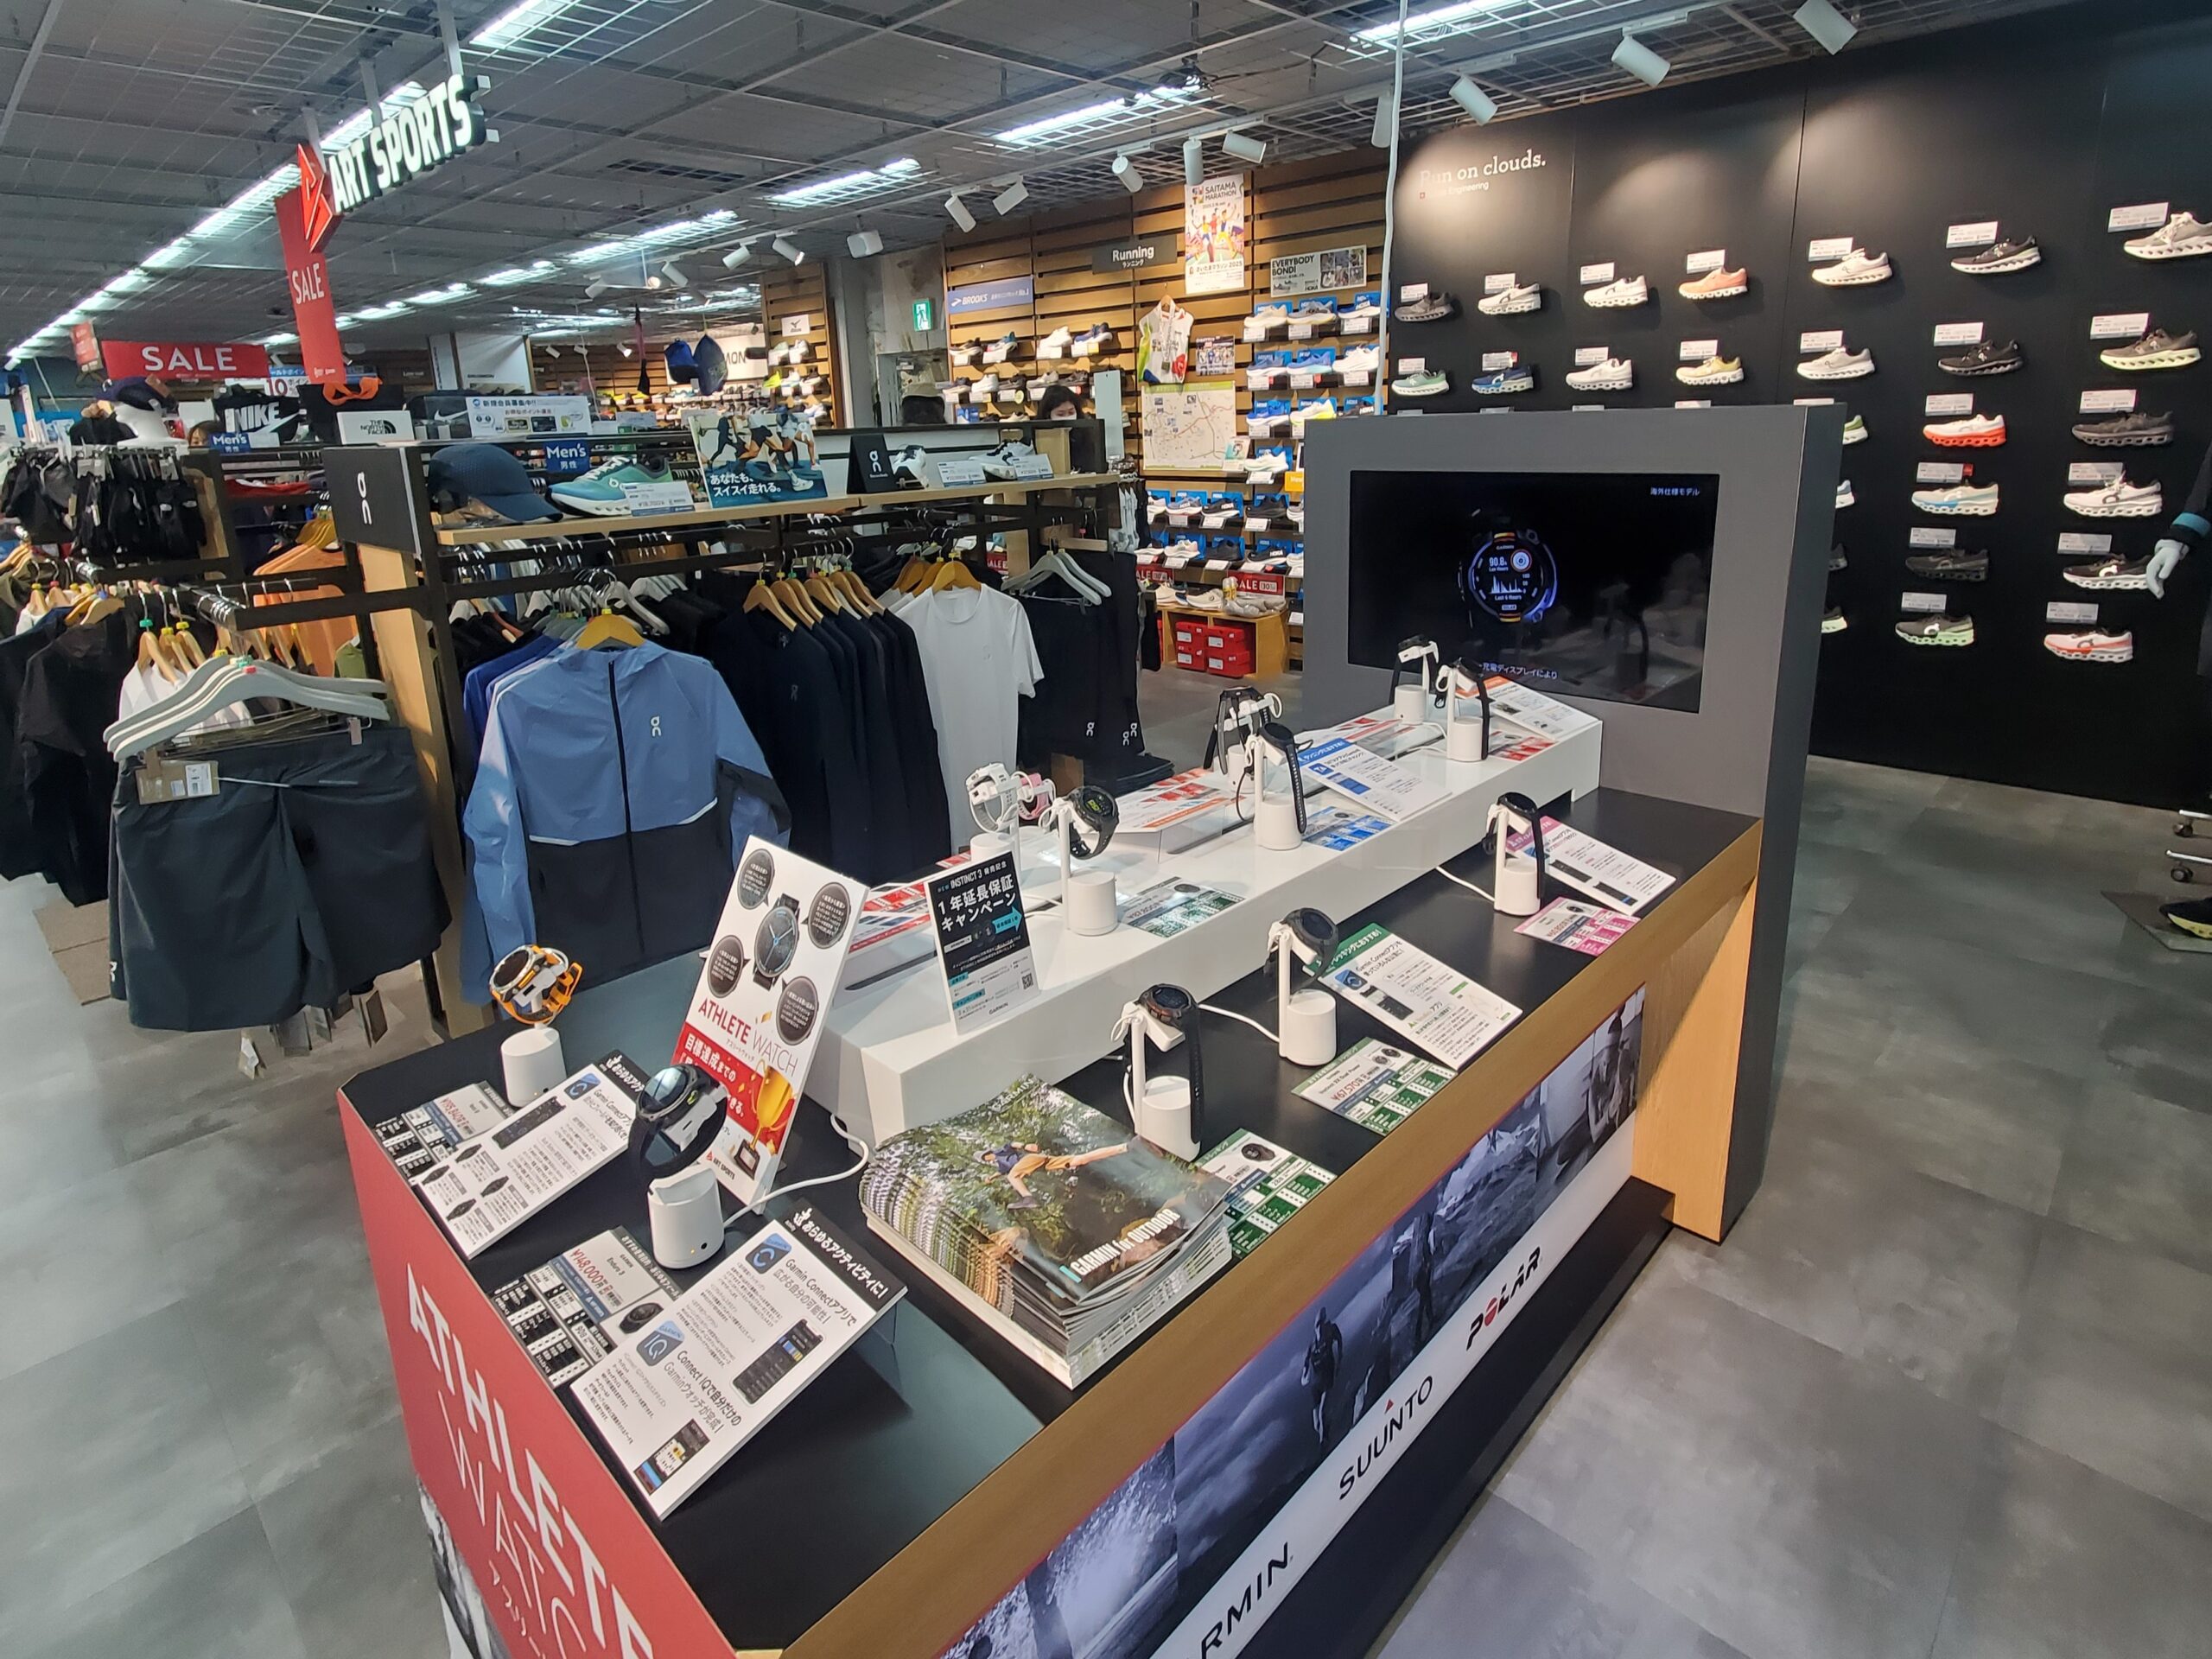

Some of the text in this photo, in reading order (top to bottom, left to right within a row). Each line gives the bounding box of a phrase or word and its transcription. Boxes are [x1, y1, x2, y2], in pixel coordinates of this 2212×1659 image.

[328, 74, 472, 213] ART SPORTS
[1457, 166, 1478, 180] on
[1484, 149, 1546, 175] clouds.
[1205, 181, 1236, 194] SAITAMA
[1205, 190, 1236, 200] MARATHON
[1112, 245, 1155, 264] Running
[1272, 256, 1315, 270] EVERYBODY
[1272, 265, 1297, 275] BONDI
[291, 262, 325, 306] SALE
[962, 295, 988, 306] BROOKS
[142, 346, 238, 372] SALE
[233, 402, 281, 433] NIKE
[546, 443, 587, 460] Men's
[560, 461, 577, 471] 男性
[710, 474, 754, 485] あなたも、
[714, 485, 782, 498] スイスイ走れる。
[1649, 487, 1700, 497] 海外仕様モデル
[949, 870, 977, 889] INSTINCT
[976, 868, 982, 878] 3
[939, 891, 1017, 932] キャンペーン
[697, 997, 753, 1044] ATHLETE
[747, 1030, 801, 1077] WATCH
[683, 1033, 738, 1083] 目標達成までの
[1070, 1205, 1181, 1277] GARMIN for OUTDOOR
[569, 1248, 604, 1285] ¥148,000
[607, 1256, 621, 1273] Enduro
[772, 1267, 831, 1325] 広がる自分の可能性!
[784, 1257, 810, 1281] Garmin
[804, 1277, 857, 1327] Connectアプリで
[1466, 1246, 1541, 1351] POLAR
[661, 1361, 723, 1433] Garminウォッチが完成!
[676, 1350, 703, 1381] Connect
[698, 1376, 742, 1427] IQで自分だけの
[1338, 1376, 1433, 1501] SUUNTO
[1198, 1541, 1289, 1659] RMIN
